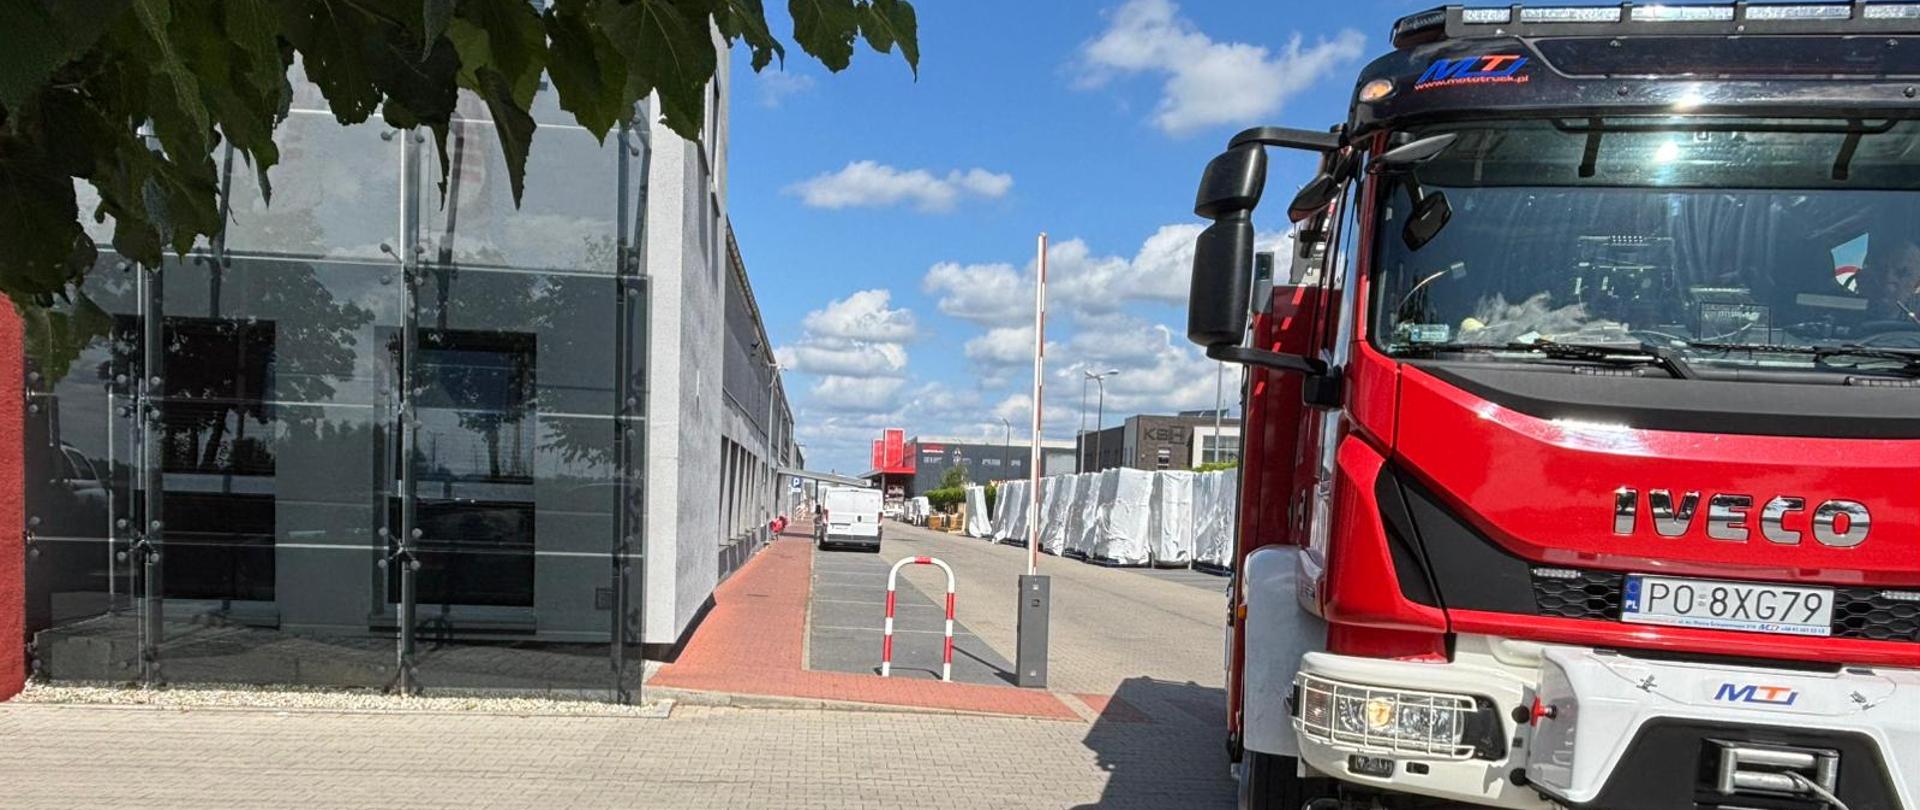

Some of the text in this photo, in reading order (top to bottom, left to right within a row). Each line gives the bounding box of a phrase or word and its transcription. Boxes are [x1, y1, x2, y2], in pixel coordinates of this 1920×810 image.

[1414, 74, 1529, 91] www.mototruck.pl
[1613, 487, 1872, 549] IVECO
[1625, 600, 1638, 610] PL
[1647, 582, 1823, 623] PO 8XG79
